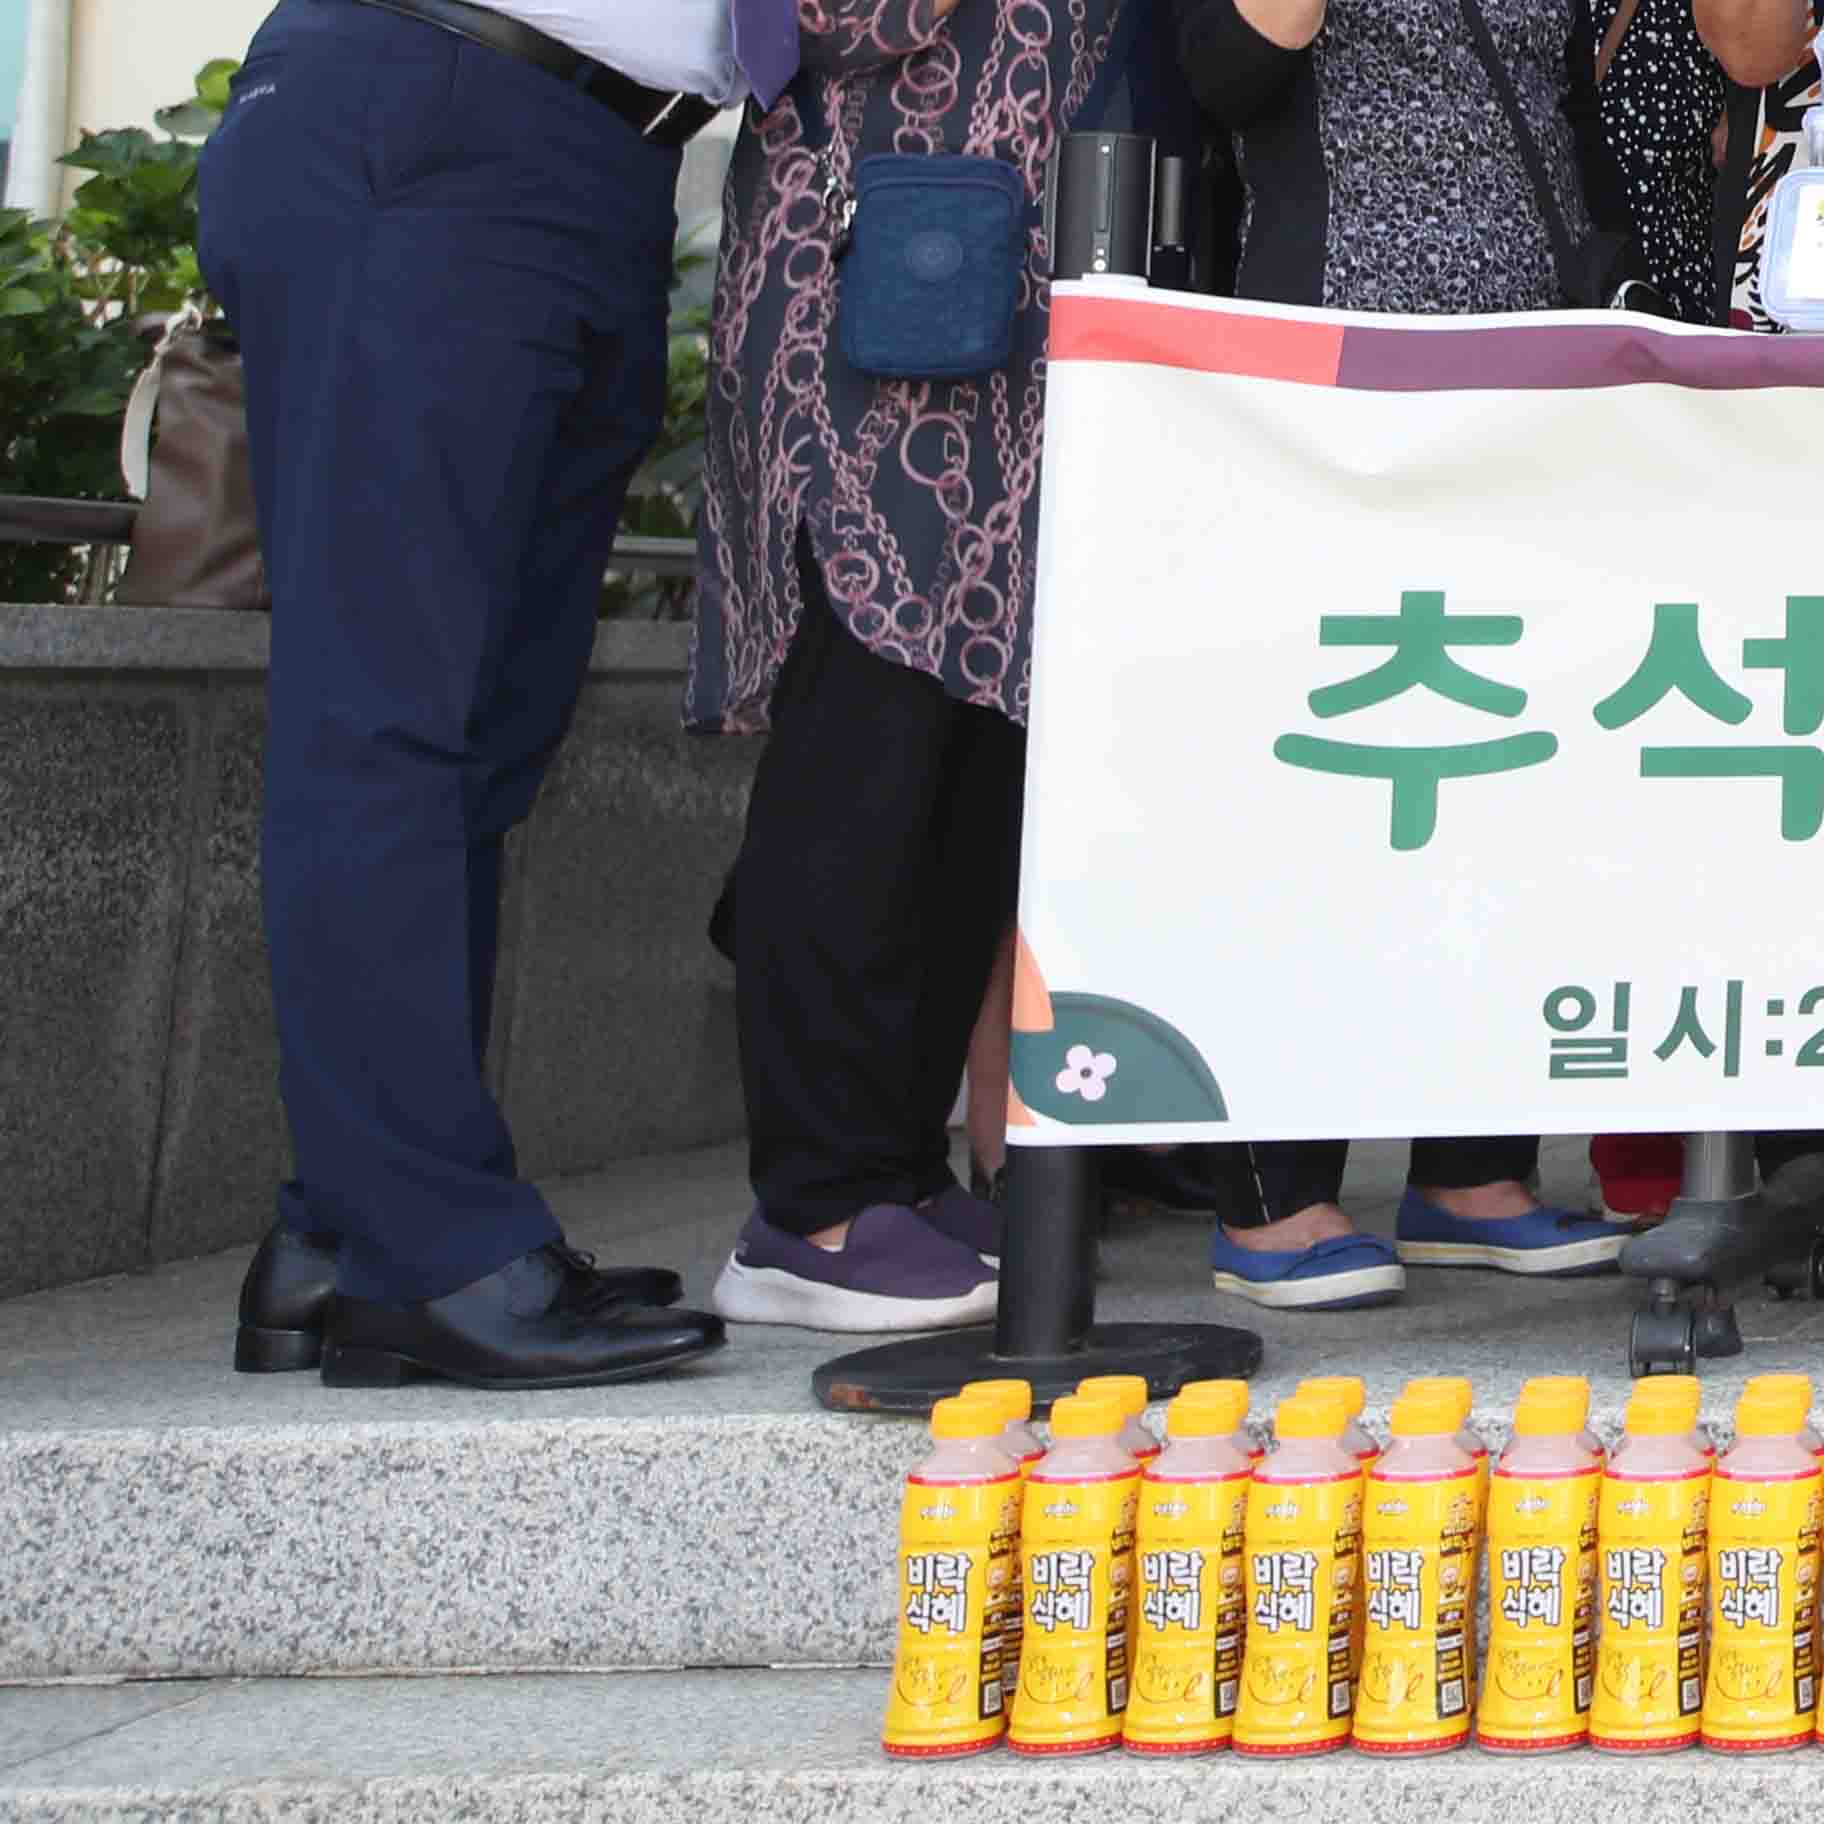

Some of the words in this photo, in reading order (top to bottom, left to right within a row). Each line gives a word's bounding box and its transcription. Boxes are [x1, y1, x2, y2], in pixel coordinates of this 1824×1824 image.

[907, 1551, 971, 1592] 비락
[1032, 1550, 1094, 1592] 비락
[1144, 1546, 1203, 1589] 비락
[1254, 1550, 1317, 1592] 비락
[1367, 1549, 1424, 1590] 비락
[1502, 1545, 1564, 1587] 비락
[1607, 1544, 1665, 1587] 비락
[1720, 1546, 1781, 1588] 비락
[907, 1589, 969, 1630] 식혜
[1032, 1589, 1092, 1632] 식혜
[1144, 1585, 1201, 1629] 식혜
[1254, 1589, 1315, 1632] 식혜
[1367, 1587, 1422, 1629] 식혜
[1502, 1584, 1562, 1627] 식혜
[1607, 1583, 1663, 1627] 식혜
[1720, 1585, 1779, 1627] 식혜
